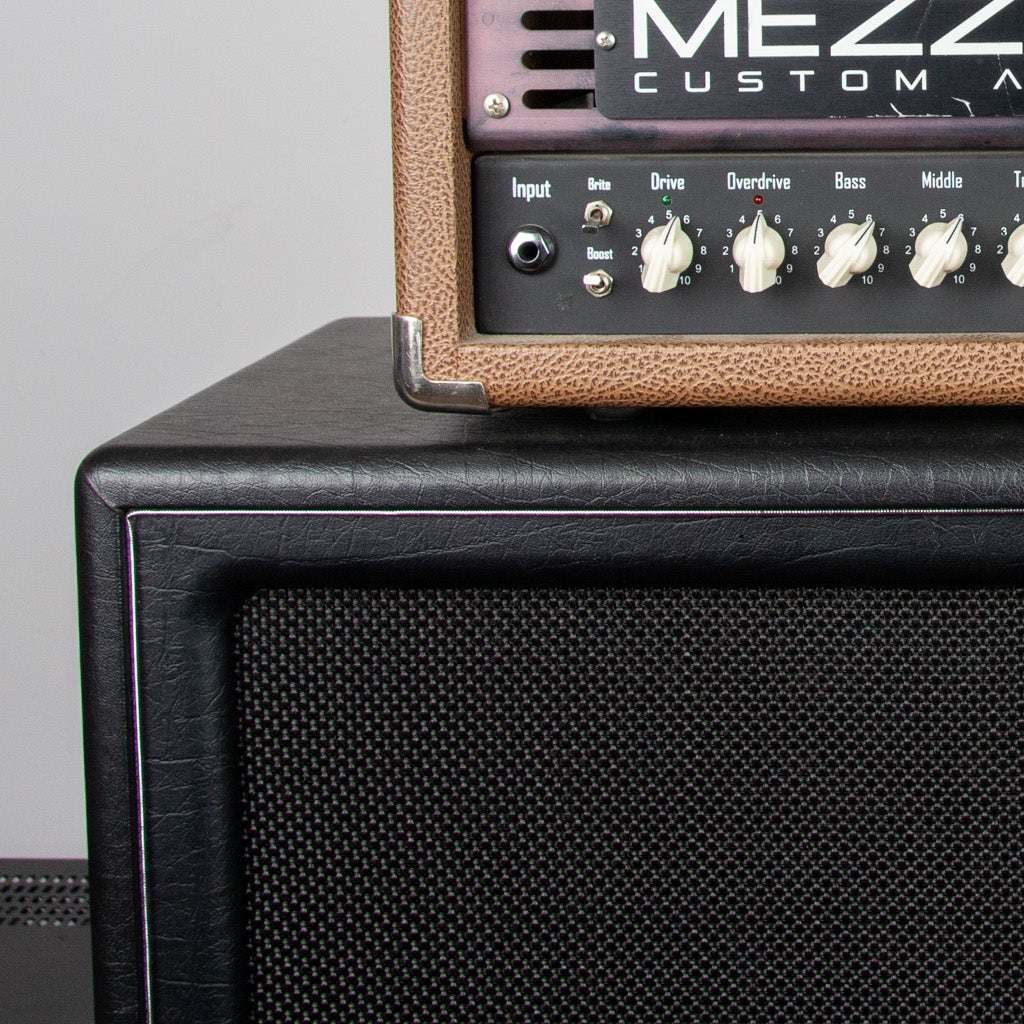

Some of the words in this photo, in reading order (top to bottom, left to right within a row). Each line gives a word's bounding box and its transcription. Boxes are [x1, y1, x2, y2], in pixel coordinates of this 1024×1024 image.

[633, 69, 928, 94] CUSTOM
[588, 178, 611, 190] Brite
[651, 172, 684, 190] Drive
[727, 172, 790, 190] Overdrive
[835, 172, 866, 189] Bass
[922, 172, 962, 189] Middle
[512, 177, 551, 202] Input
[849, 210, 854, 218] 5
[940, 209, 946, 218] 5
[648, 215, 654, 224] 4
[684, 215, 690, 224] 6
[739, 215, 745, 224] 4
[775, 215, 781, 224] 6
[830, 215, 836, 223] 4
[922, 214, 928, 223] 4
[636, 229, 642, 237] 3
[697, 229, 702, 237] 7
[727, 229, 732, 237] 3
[788, 228, 794, 237] 7
[818, 228, 824, 237] 3
[879, 228, 885, 236] 7
[909, 228, 915, 237] 3
[971, 228, 977, 236] 7
[997, 245, 1003, 254] 2
[1001, 227, 1007, 236] 3
[1014, 214, 1020, 222] 4
[587, 247, 613, 260] Boost
[632, 247, 638, 255] 2
[700, 246, 707, 255] 8
[722, 246, 728, 255] 2
[792, 246, 798, 254] 8
[814, 246, 820, 255] 2
[883, 246, 890, 254] 8
[905, 246, 911, 254] 2
[975, 245, 981, 254] 8
[695, 264, 702, 273] 9
[787, 264, 793, 273] 9
[878, 264, 884, 272] 9
[970, 263, 976, 272] 9
[862, 276, 873, 284] 10
[953, 275, 965, 284] 10
